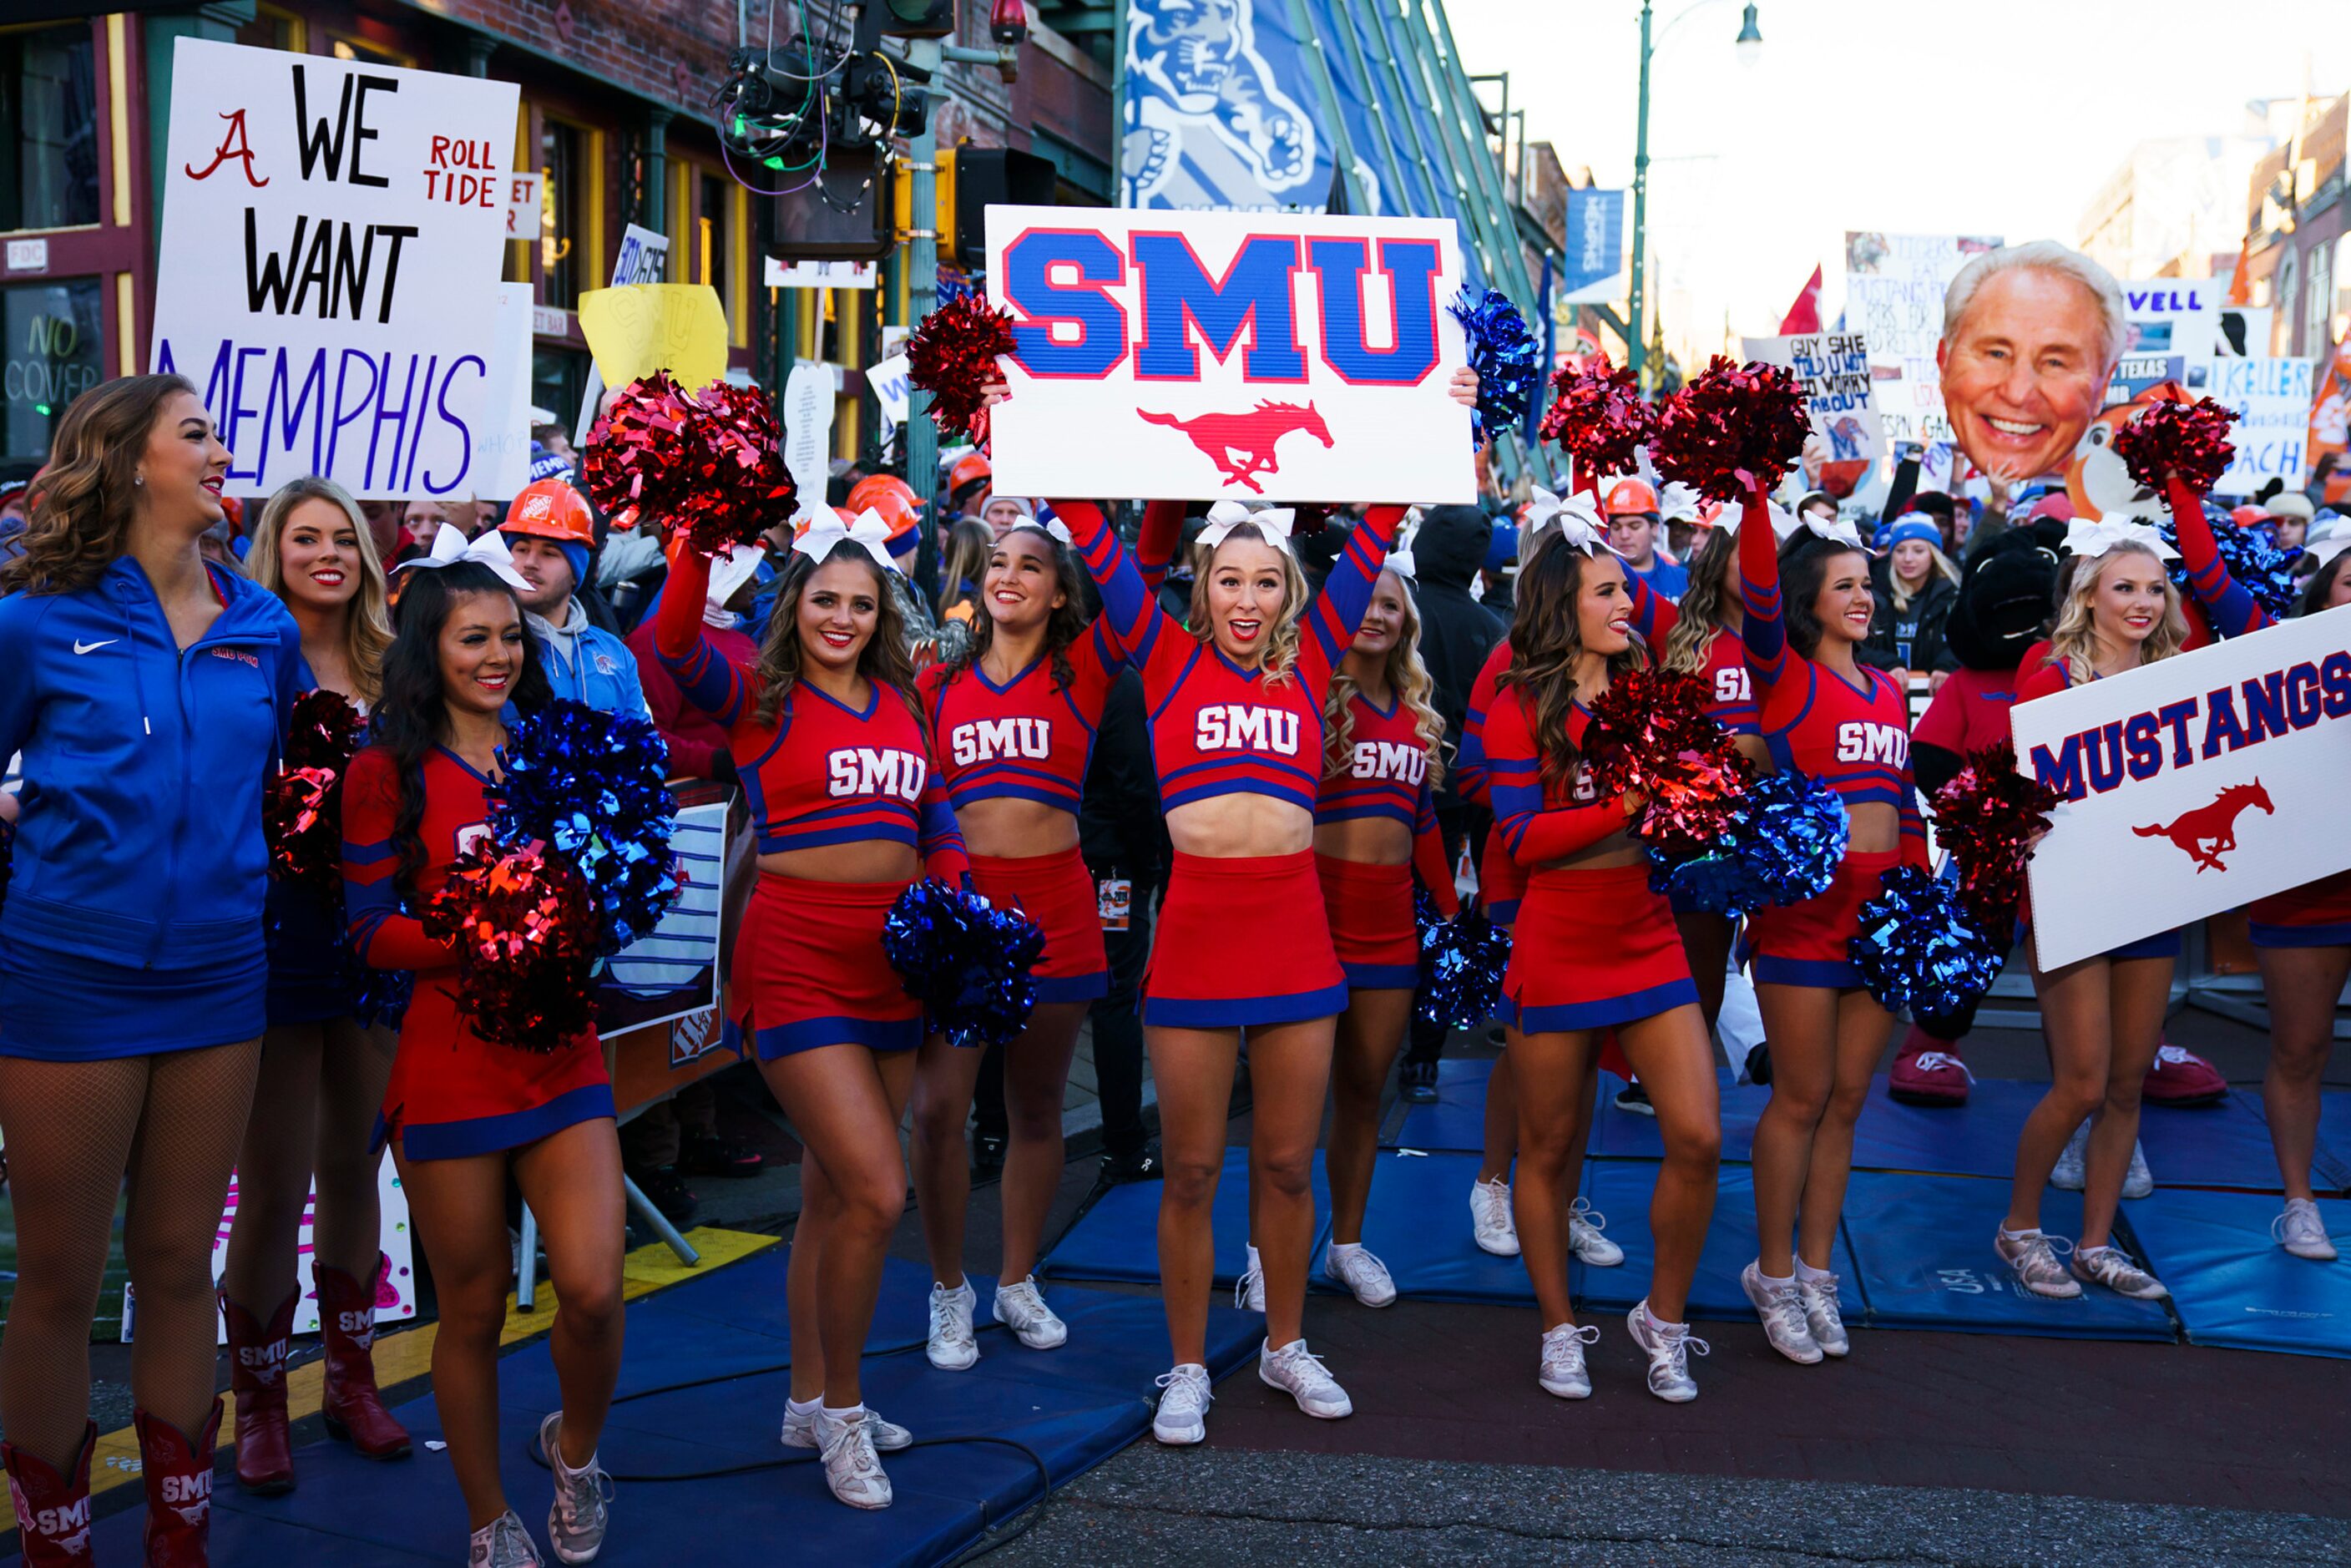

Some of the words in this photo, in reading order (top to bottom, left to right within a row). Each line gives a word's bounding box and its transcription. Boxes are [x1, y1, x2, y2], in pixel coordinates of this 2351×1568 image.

[292, 64, 398, 188] WE
[185, 109, 270, 188] A
[431, 134, 496, 170] ROLL
[423, 169, 497, 208] TIDE
[511, 180, 533, 204] ET
[245, 206, 419, 325] WANT
[1002, 226, 1443, 387] SMU
[2127, 290, 2203, 311] VELL
[28, 314, 77, 357] NO
[1790, 336, 1820, 357] GUY
[1828, 335, 1867, 354] SHE
[1823, 373, 1871, 395] WORRY
[1828, 355, 1841, 375] U
[2120, 357, 2168, 380] TEXAS
[157, 338, 486, 494] MEMPHIS
[1810, 392, 1869, 414] ABOUT
[211, 646, 236, 660] SMU
[953, 717, 1050, 766] SMU
[1197, 705, 1300, 756] SMU
[1837, 722, 1909, 771] SMU
[2030, 650, 2351, 803] MUSTANGS
[828, 748, 927, 802] SMU
[1352, 741, 1428, 787] SMU
[240, 1338, 286, 1367] SMU
[161, 1467, 214, 1503] SMU
